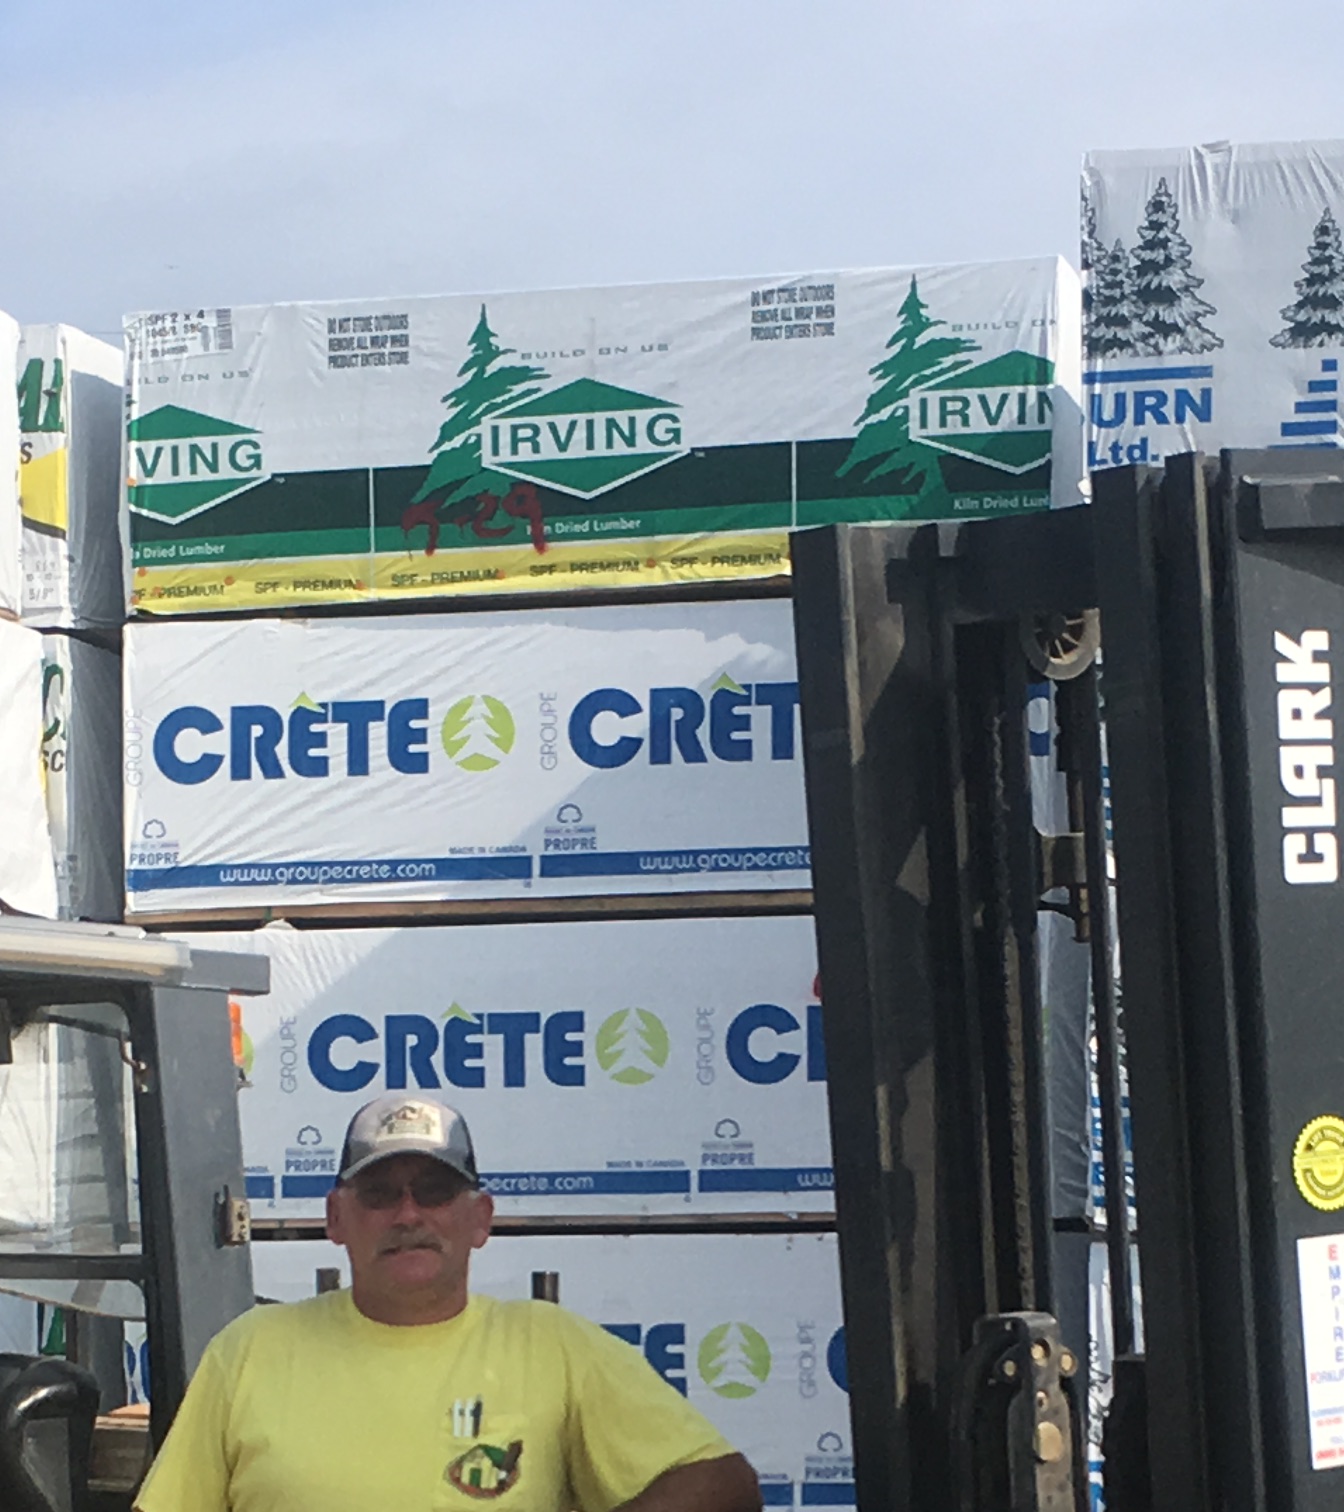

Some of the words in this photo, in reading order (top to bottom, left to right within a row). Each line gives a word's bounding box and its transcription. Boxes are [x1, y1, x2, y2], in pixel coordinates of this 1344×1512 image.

[951, 319, 1019, 332] BUILD
[519, 349, 587, 361] BUILD
[598, 345, 630, 357] ON
[640, 342, 670, 354] US
[489, 412, 683, 457] IRVING
[1087, 437, 1160, 467] Ltd.
[982, 495, 1022, 510] Dried
[555, 520, 590, 534] Dried
[593, 518, 641, 533] Lumber
[143, 544, 176, 559] Dried
[178, 542, 225, 557] Lumber
[529, 564, 556, 577] SPF
[570, 560, 640, 575] PREMIUM
[670, 556, 698, 569] SPF
[711, 553, 782, 568] PREMIUM
[255, 580, 280, 594] SPF
[292, 578, 360, 592] PREMIUM
[391, 573, 419, 587] SPF
[431, 569, 499, 585] PREMIUM
[160, 584, 226, 599] PREMIUM
[152, 691, 431, 786] CRÊTE
[539, 691, 559, 772] GROUPE
[1274, 629, 1339, 885] CLARK
[543, 836, 598, 851] PROPRE
[130, 852, 180, 866] PROPRE
[218, 862, 437, 885] www.groupecrete.com
[307, 1000, 587, 1094] CRÊTE
[696, 1004, 716, 1087] GROUPE
[279, 1014, 299, 1095] GROUPE
[285, 1158, 336, 1172] PROPRE
[701, 1151, 755, 1167] PROPRE
[1327, 1243, 1344, 1363] EMPIRE
